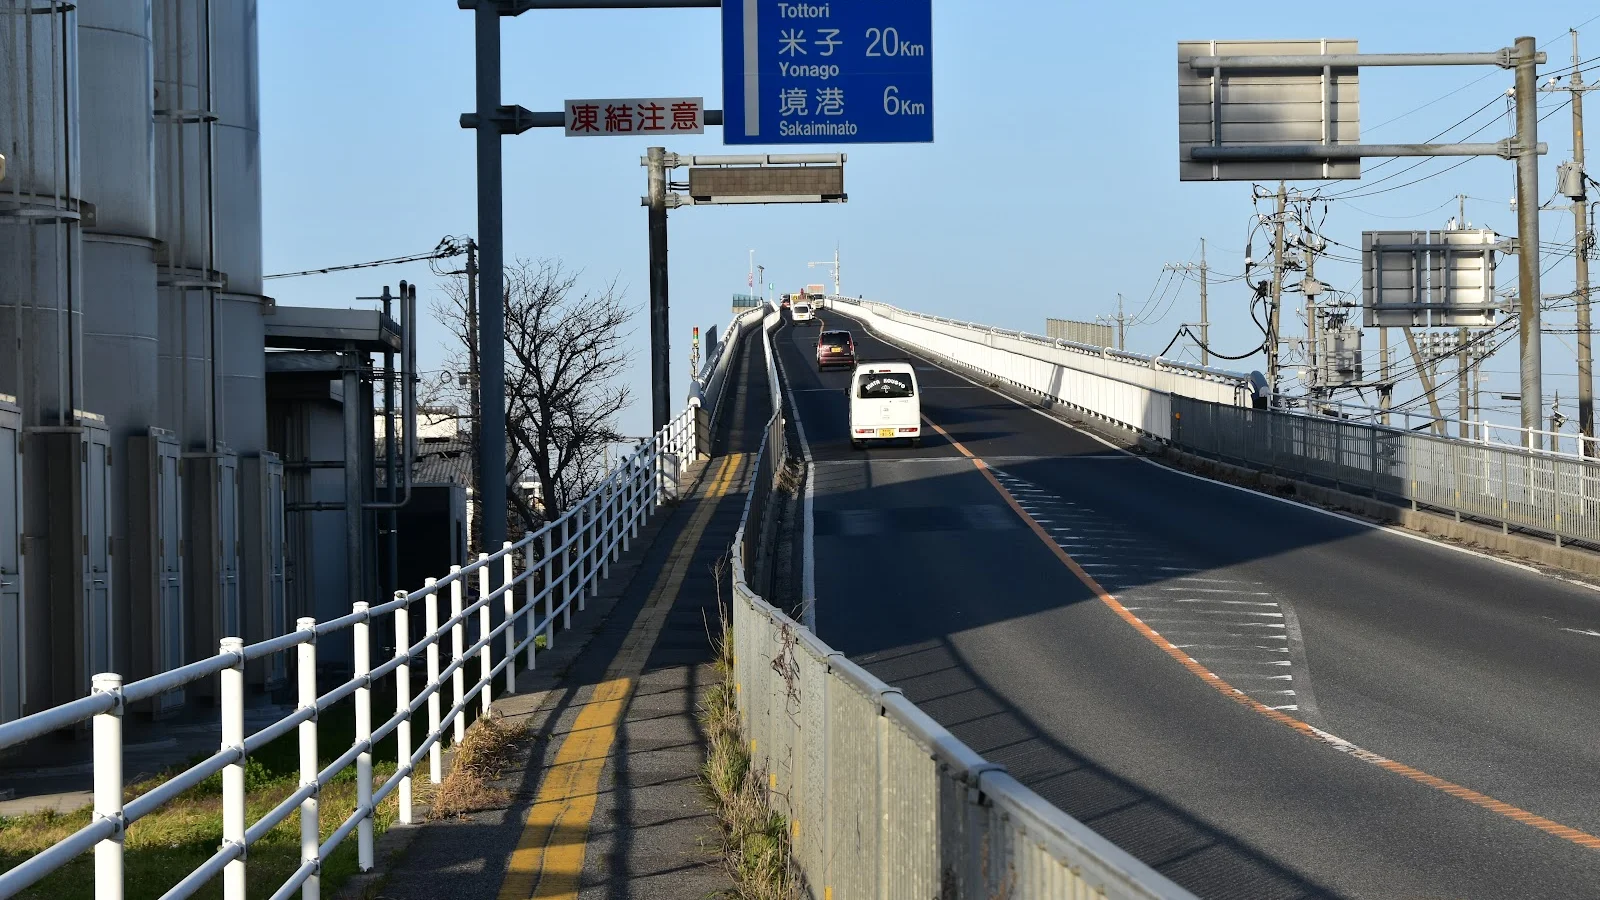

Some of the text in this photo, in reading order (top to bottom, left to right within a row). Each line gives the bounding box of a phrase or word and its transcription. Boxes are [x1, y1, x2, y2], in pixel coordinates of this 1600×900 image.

[778, 3, 830, 18] Tottori
[778, 28, 843, 57] 米子
[778, 61, 840, 80] Yonago
[778, 87, 844, 117] 境港
[570, 101, 699, 133] 凍結注意
[779, 120, 858, 137] Sakaiminato
